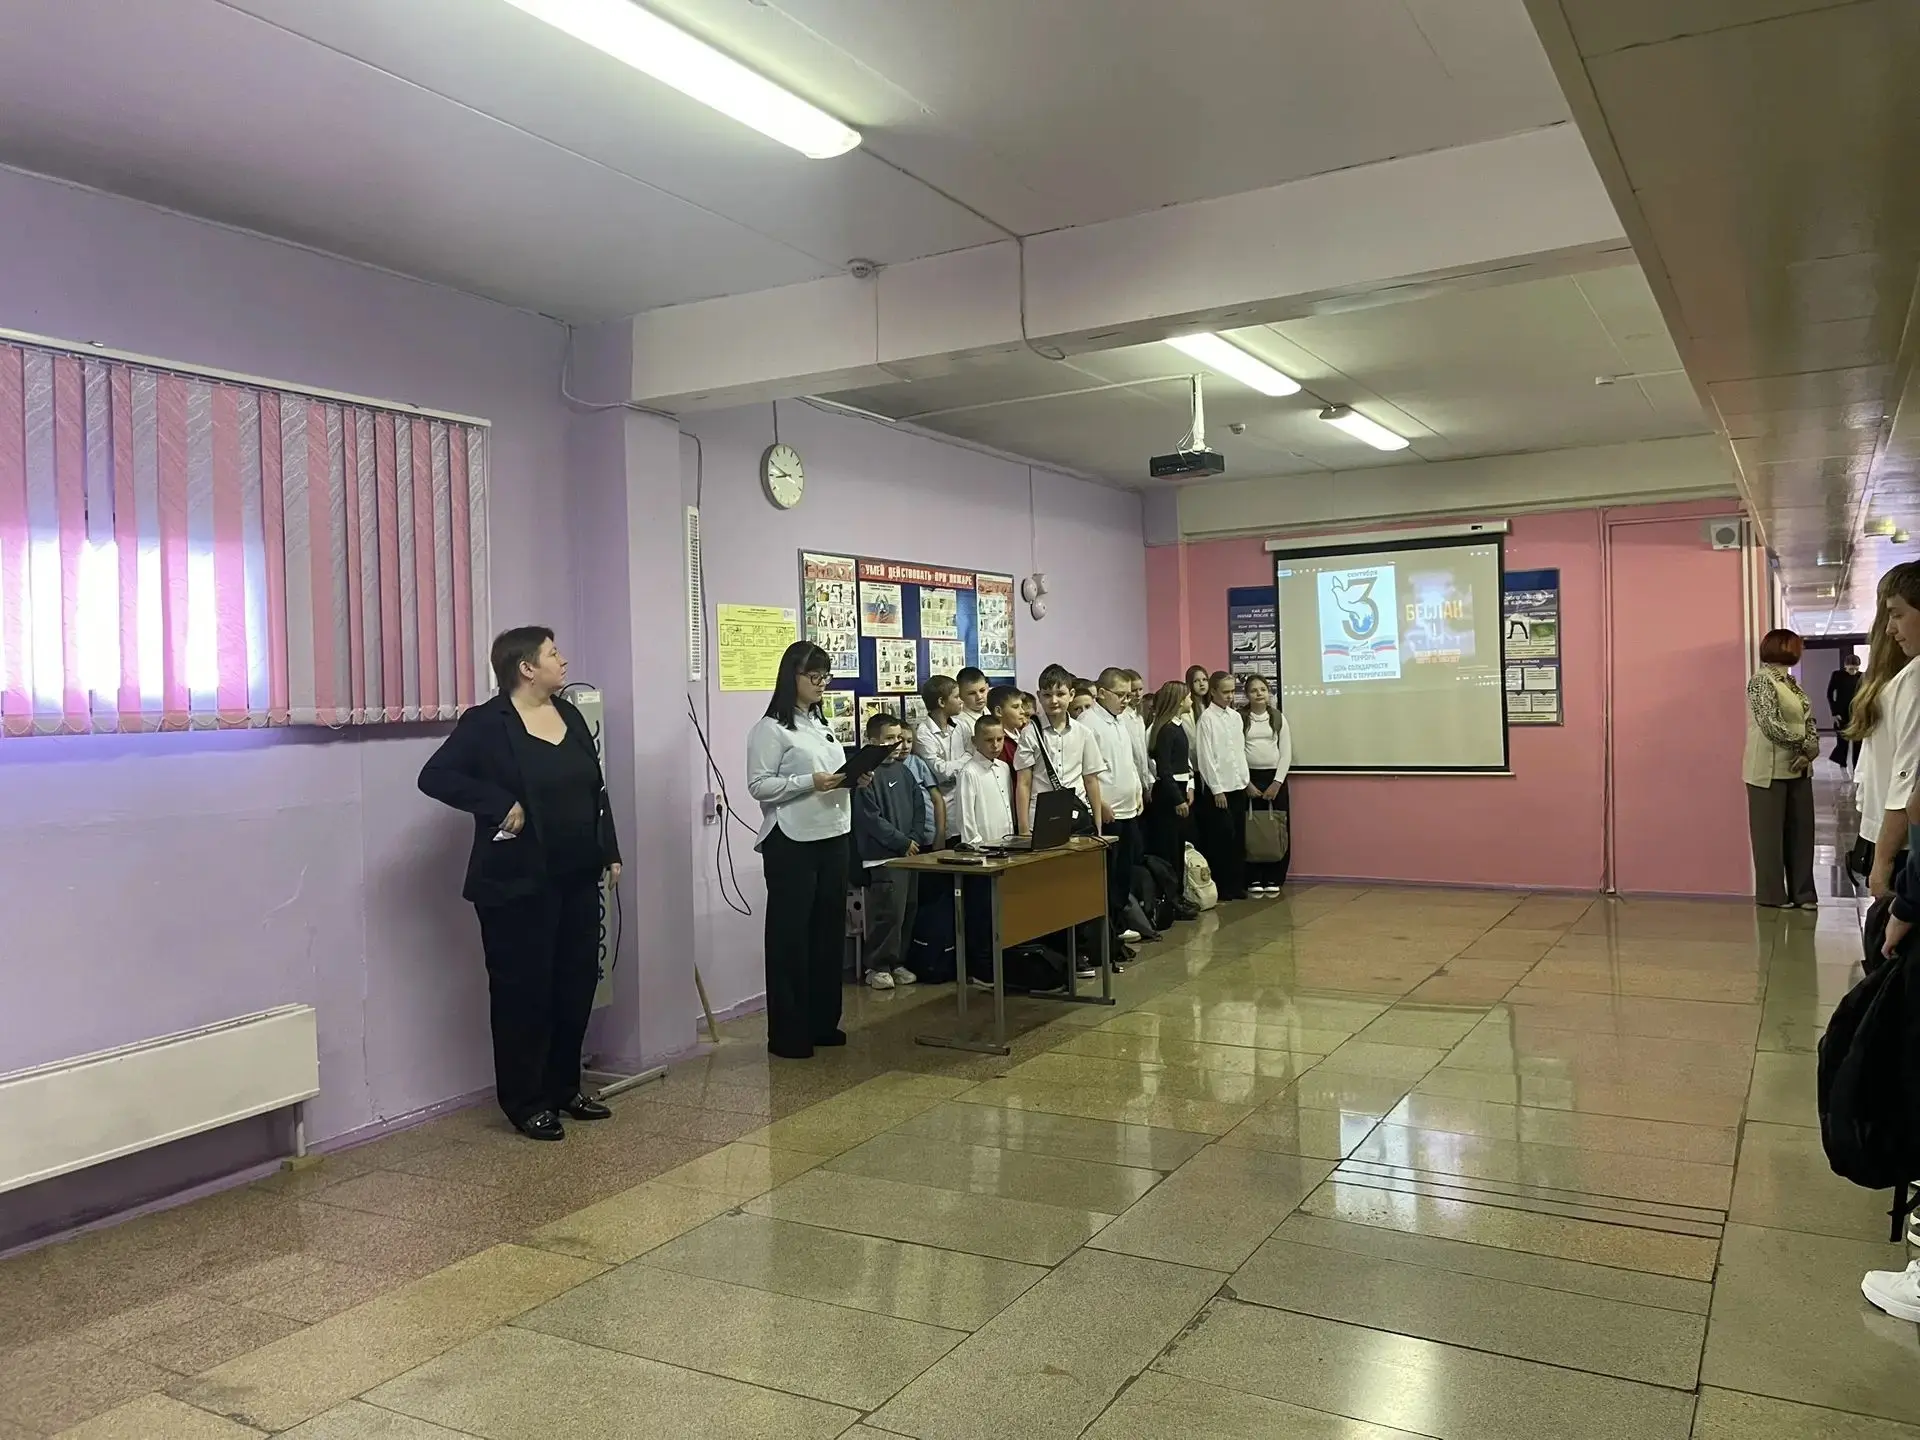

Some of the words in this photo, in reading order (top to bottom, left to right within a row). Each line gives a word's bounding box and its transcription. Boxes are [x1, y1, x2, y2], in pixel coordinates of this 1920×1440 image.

[865, 564, 885, 576] УМЕЙ
[888, 566, 932, 581] ДЕЙСТВОВАТЬ
[934, 572, 947, 582] ПРИ
[949, 574, 973, 585] ПОЖАРЕ
[1342, 576, 1380, 641] 3
[1405, 599, 1463, 621] БЕСЛАН
